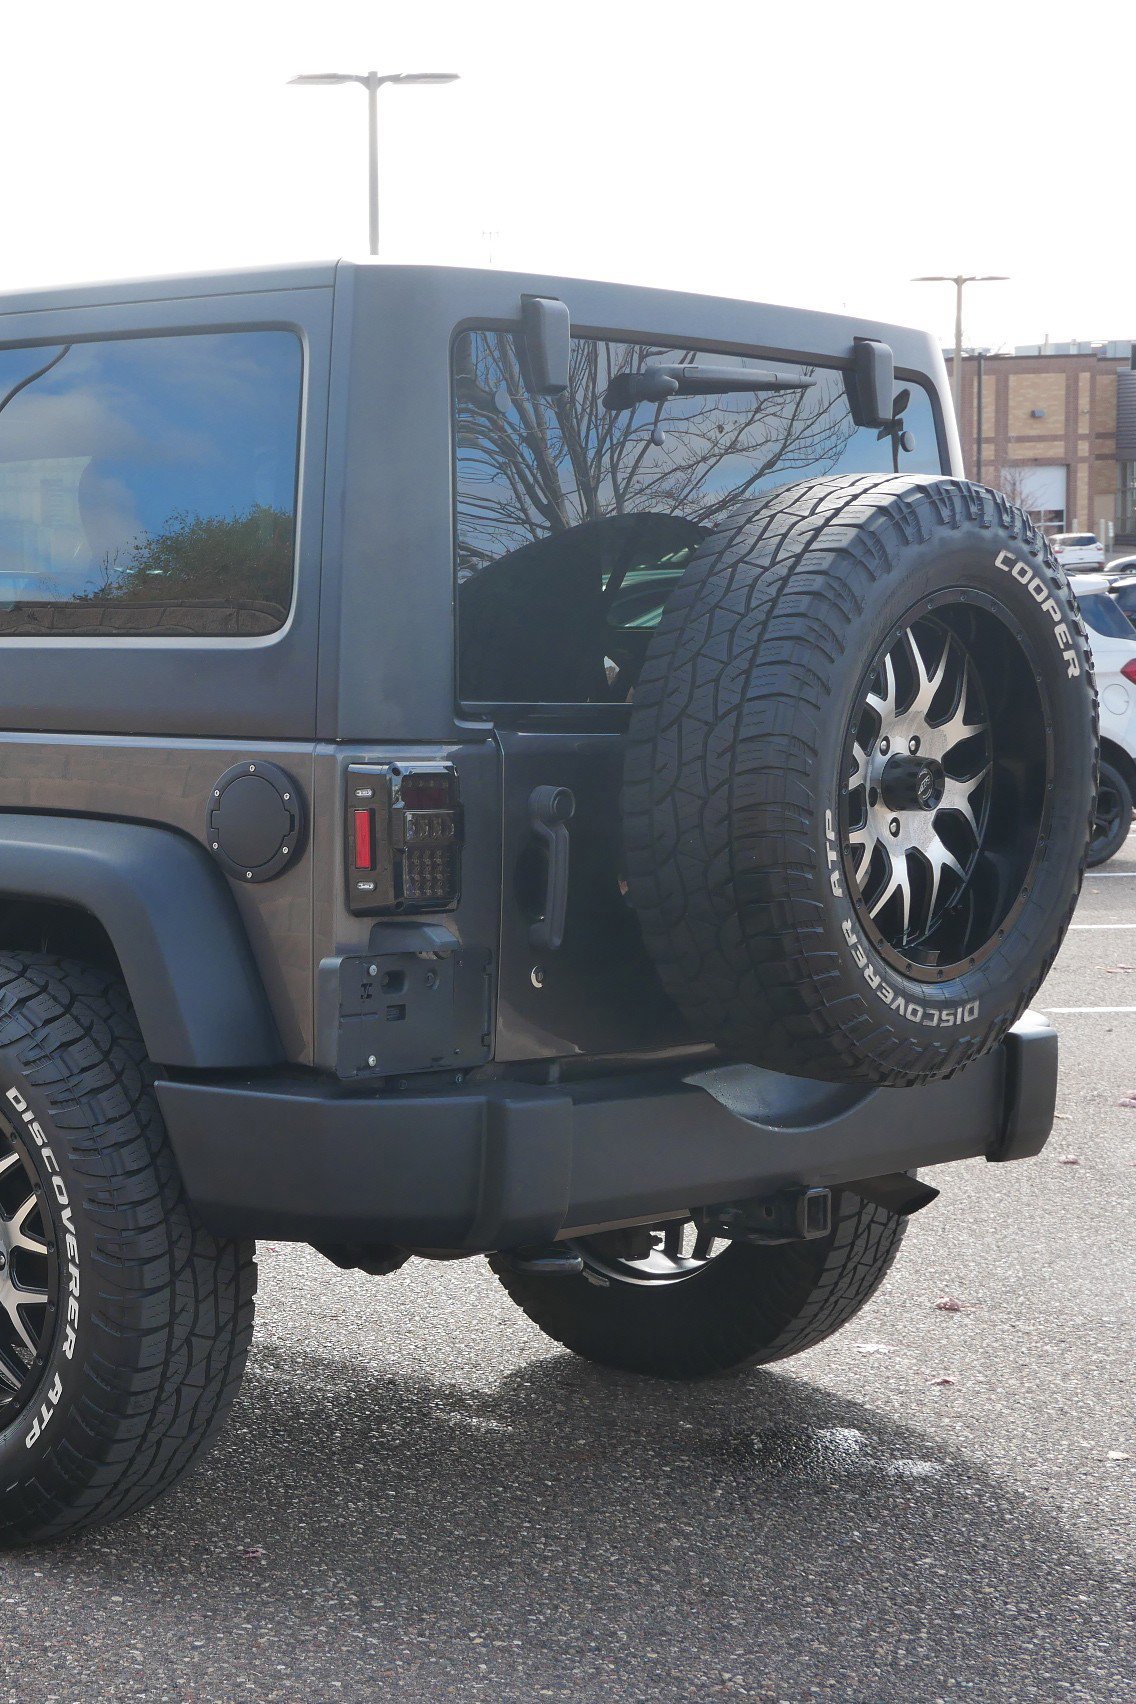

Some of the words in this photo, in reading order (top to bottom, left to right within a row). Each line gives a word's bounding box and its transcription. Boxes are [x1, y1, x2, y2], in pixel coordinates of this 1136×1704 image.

[994, 549, 1080, 679] COOPER
[825, 809, 843, 898] ATP
[841, 918, 980, 1027] DISCOVERER
[5, 1086, 81, 1360] DISCOVERER
[25, 1371, 64, 1449] ATP
